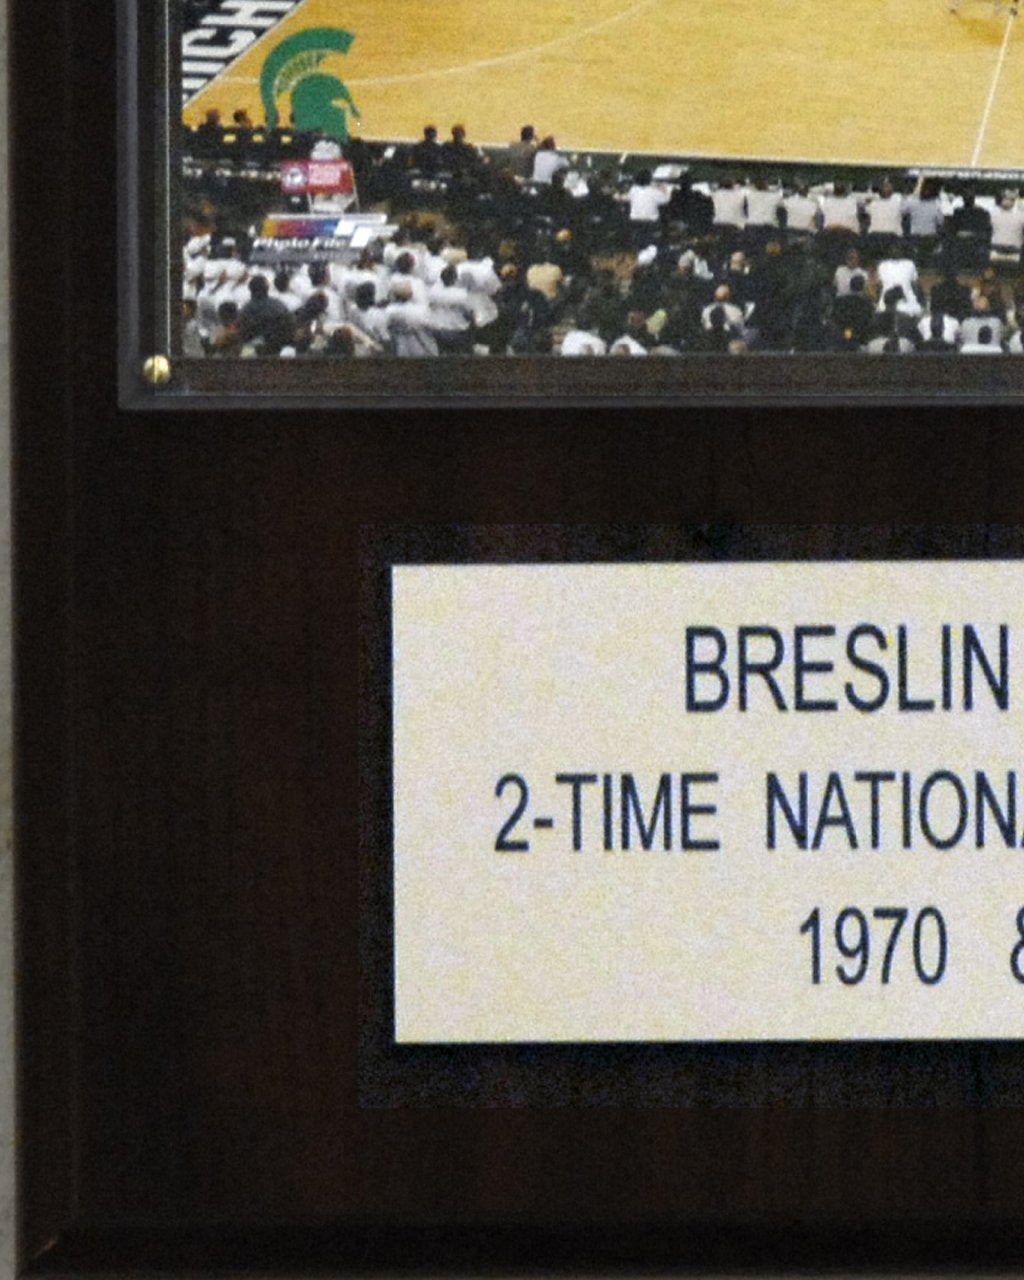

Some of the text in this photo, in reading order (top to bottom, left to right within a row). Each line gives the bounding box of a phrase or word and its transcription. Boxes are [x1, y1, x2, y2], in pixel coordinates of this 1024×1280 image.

[685, 623, 1009, 713] BRESLIN
[494, 772, 720, 853] 2-TIME
[799, 906, 948, 986] 1970
